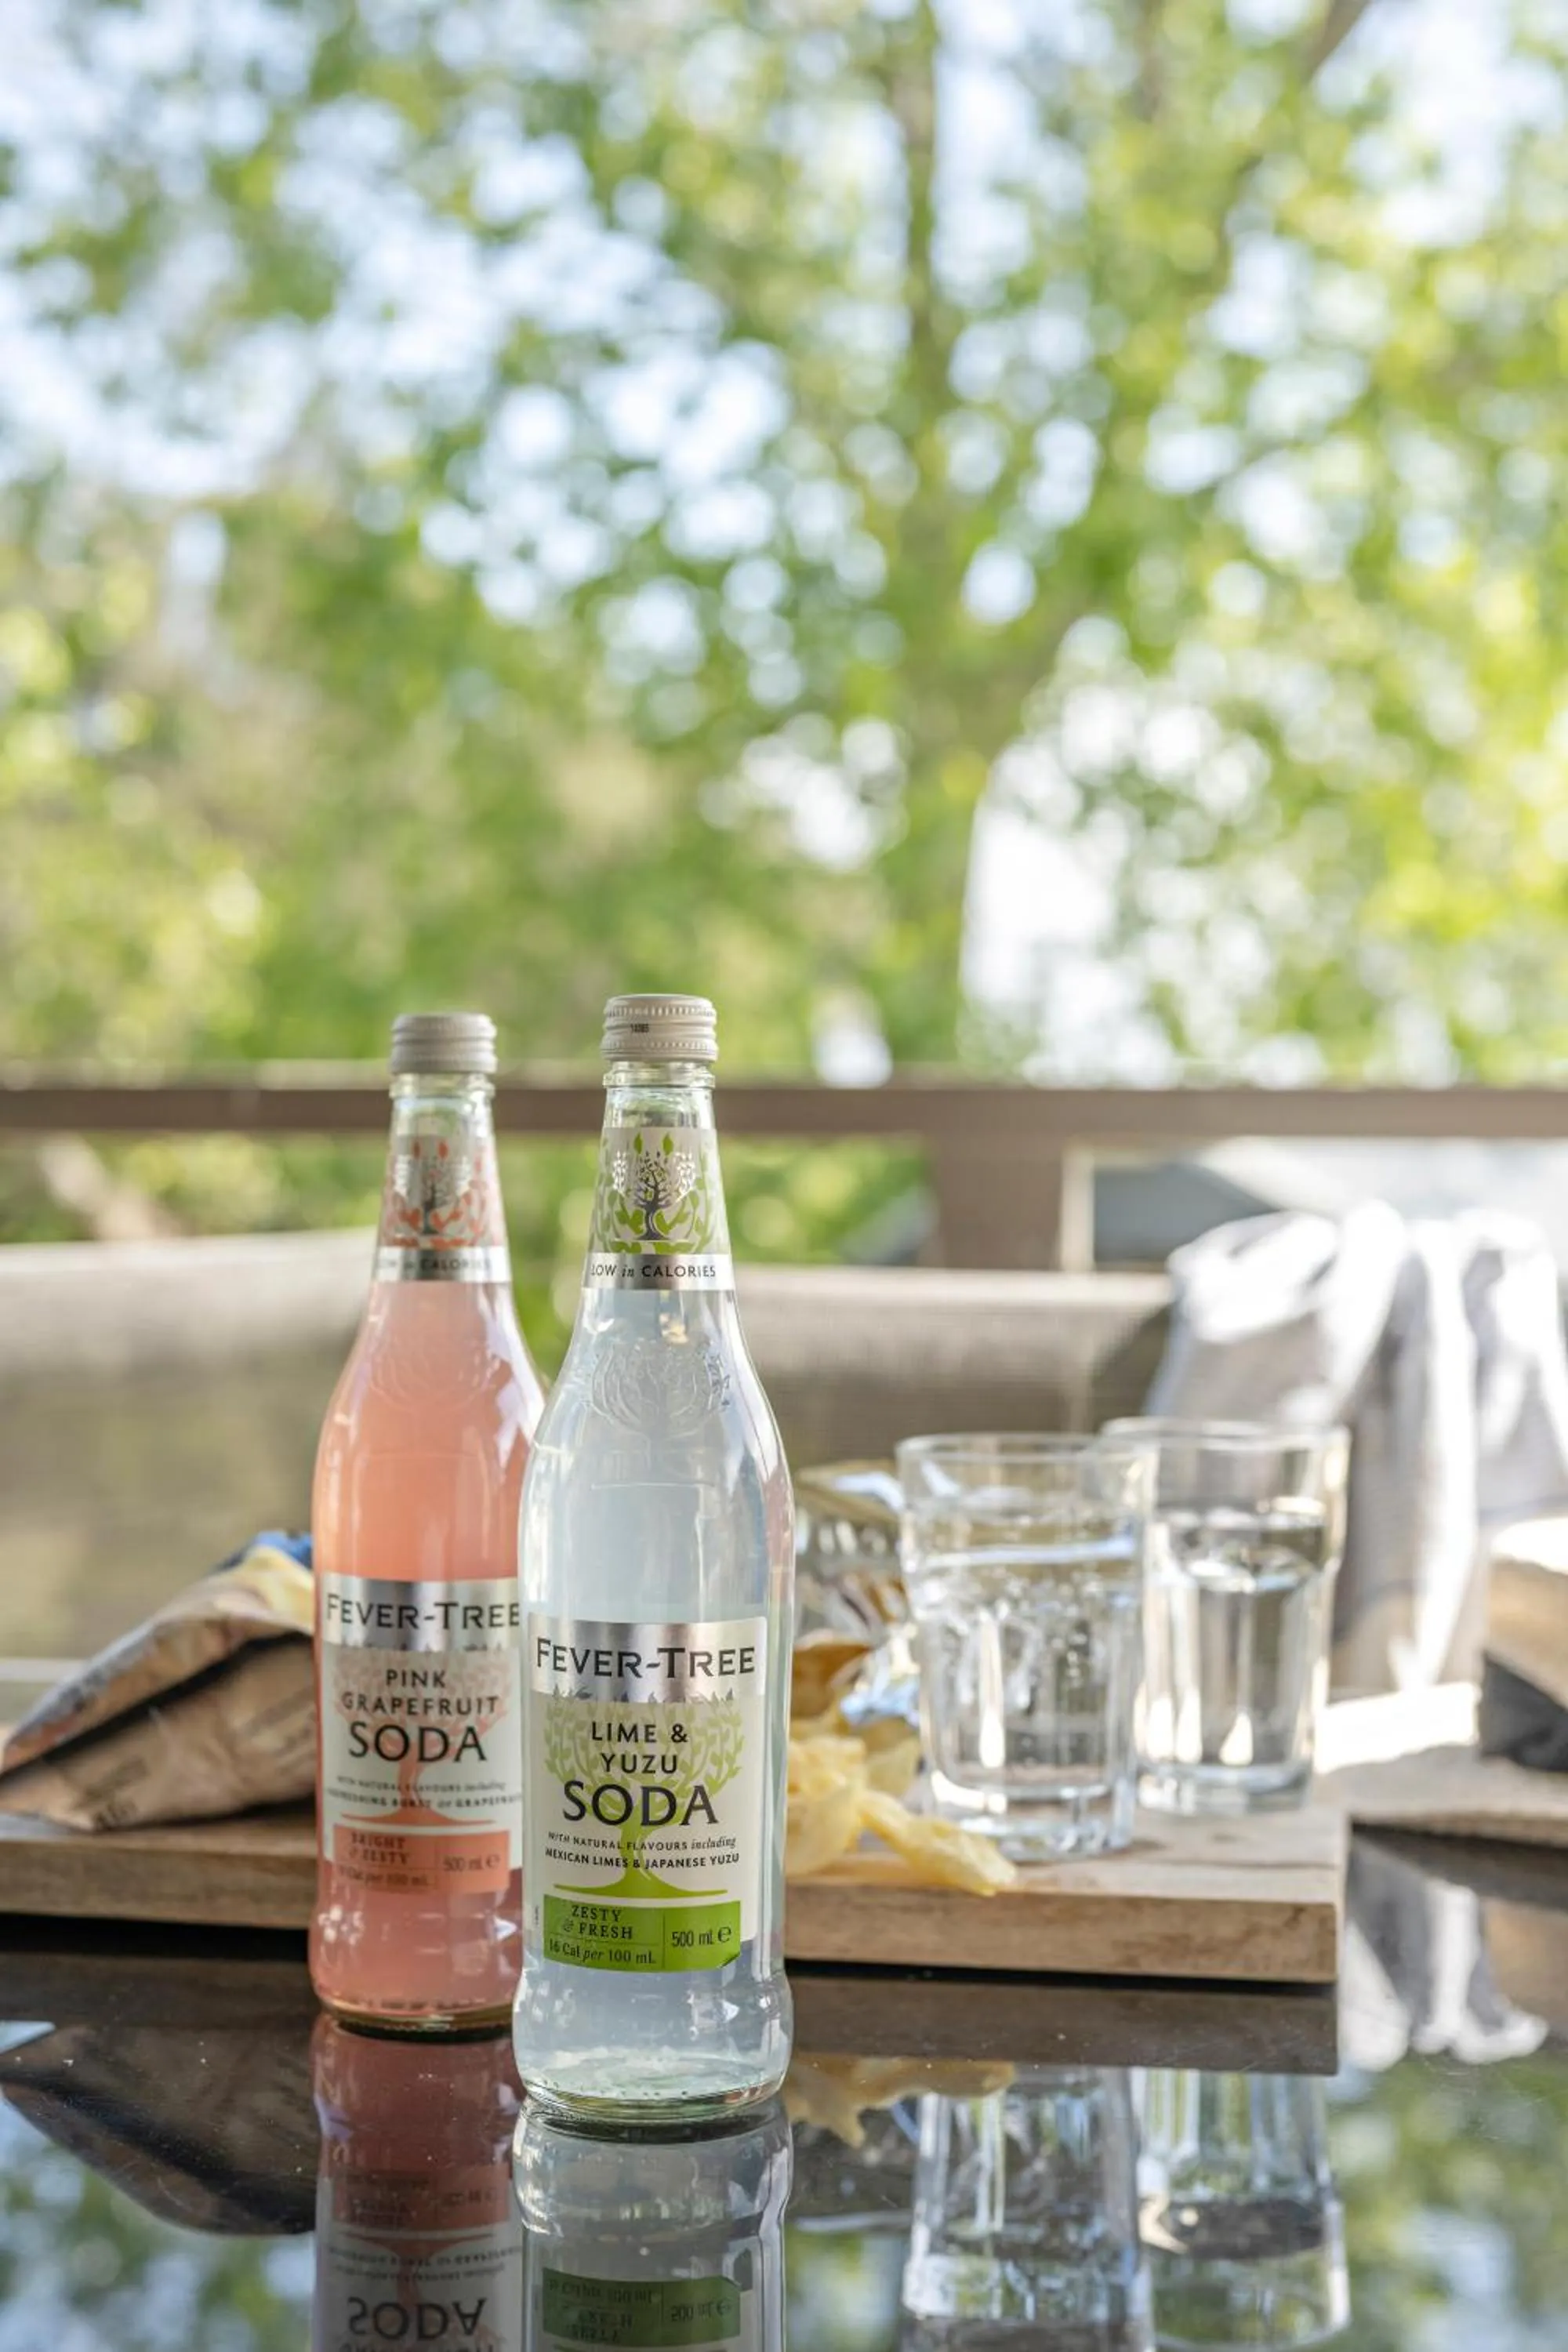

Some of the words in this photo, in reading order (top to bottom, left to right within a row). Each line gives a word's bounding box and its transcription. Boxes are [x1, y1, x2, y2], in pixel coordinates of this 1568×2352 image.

[591, 1264, 617, 1277] LOW
[622, 1265, 635, 1278] in
[641, 1265, 717, 1279] CALORIES
[327, 1593, 520, 1630] FEVER-TREE
[537, 1637, 756, 1679] FEVER-TREE
[386, 1668, 446, 1688] PINK
[341, 1691, 499, 1716] GRAPEFRUIT
[348, 1721, 488, 1762] SODA
[592, 1722, 657, 1743] LIME
[671, 1723, 688, 1743] &
[601, 1753, 677, 1774] YUZU
[562, 1780, 719, 1827] SODA
[548, 1831, 571, 1843] WITH
[573, 1836, 624, 1849] NATURAL
[626, 1841, 688, 1851] FLAVOURS
[691, 1835, 736, 1849] including
[545, 1847, 590, 1864] MEXICAN
[593, 1856, 629, 1868] LIMES
[633, 1859, 641, 1868] &
[644, 1857, 706, 1870] JAPANESE
[710, 1852, 740, 1865] YUZU
[572, 1904, 622, 1922] ZESTY
[562, 1918, 575, 1933] &
[578, 1922, 633, 1940] FRESH
[671, 1930, 694, 1947] 500
[562, 1942, 580, 1958] Cal
[583, 1949, 604, 1962] per
[608, 1949, 632, 1962] 100
